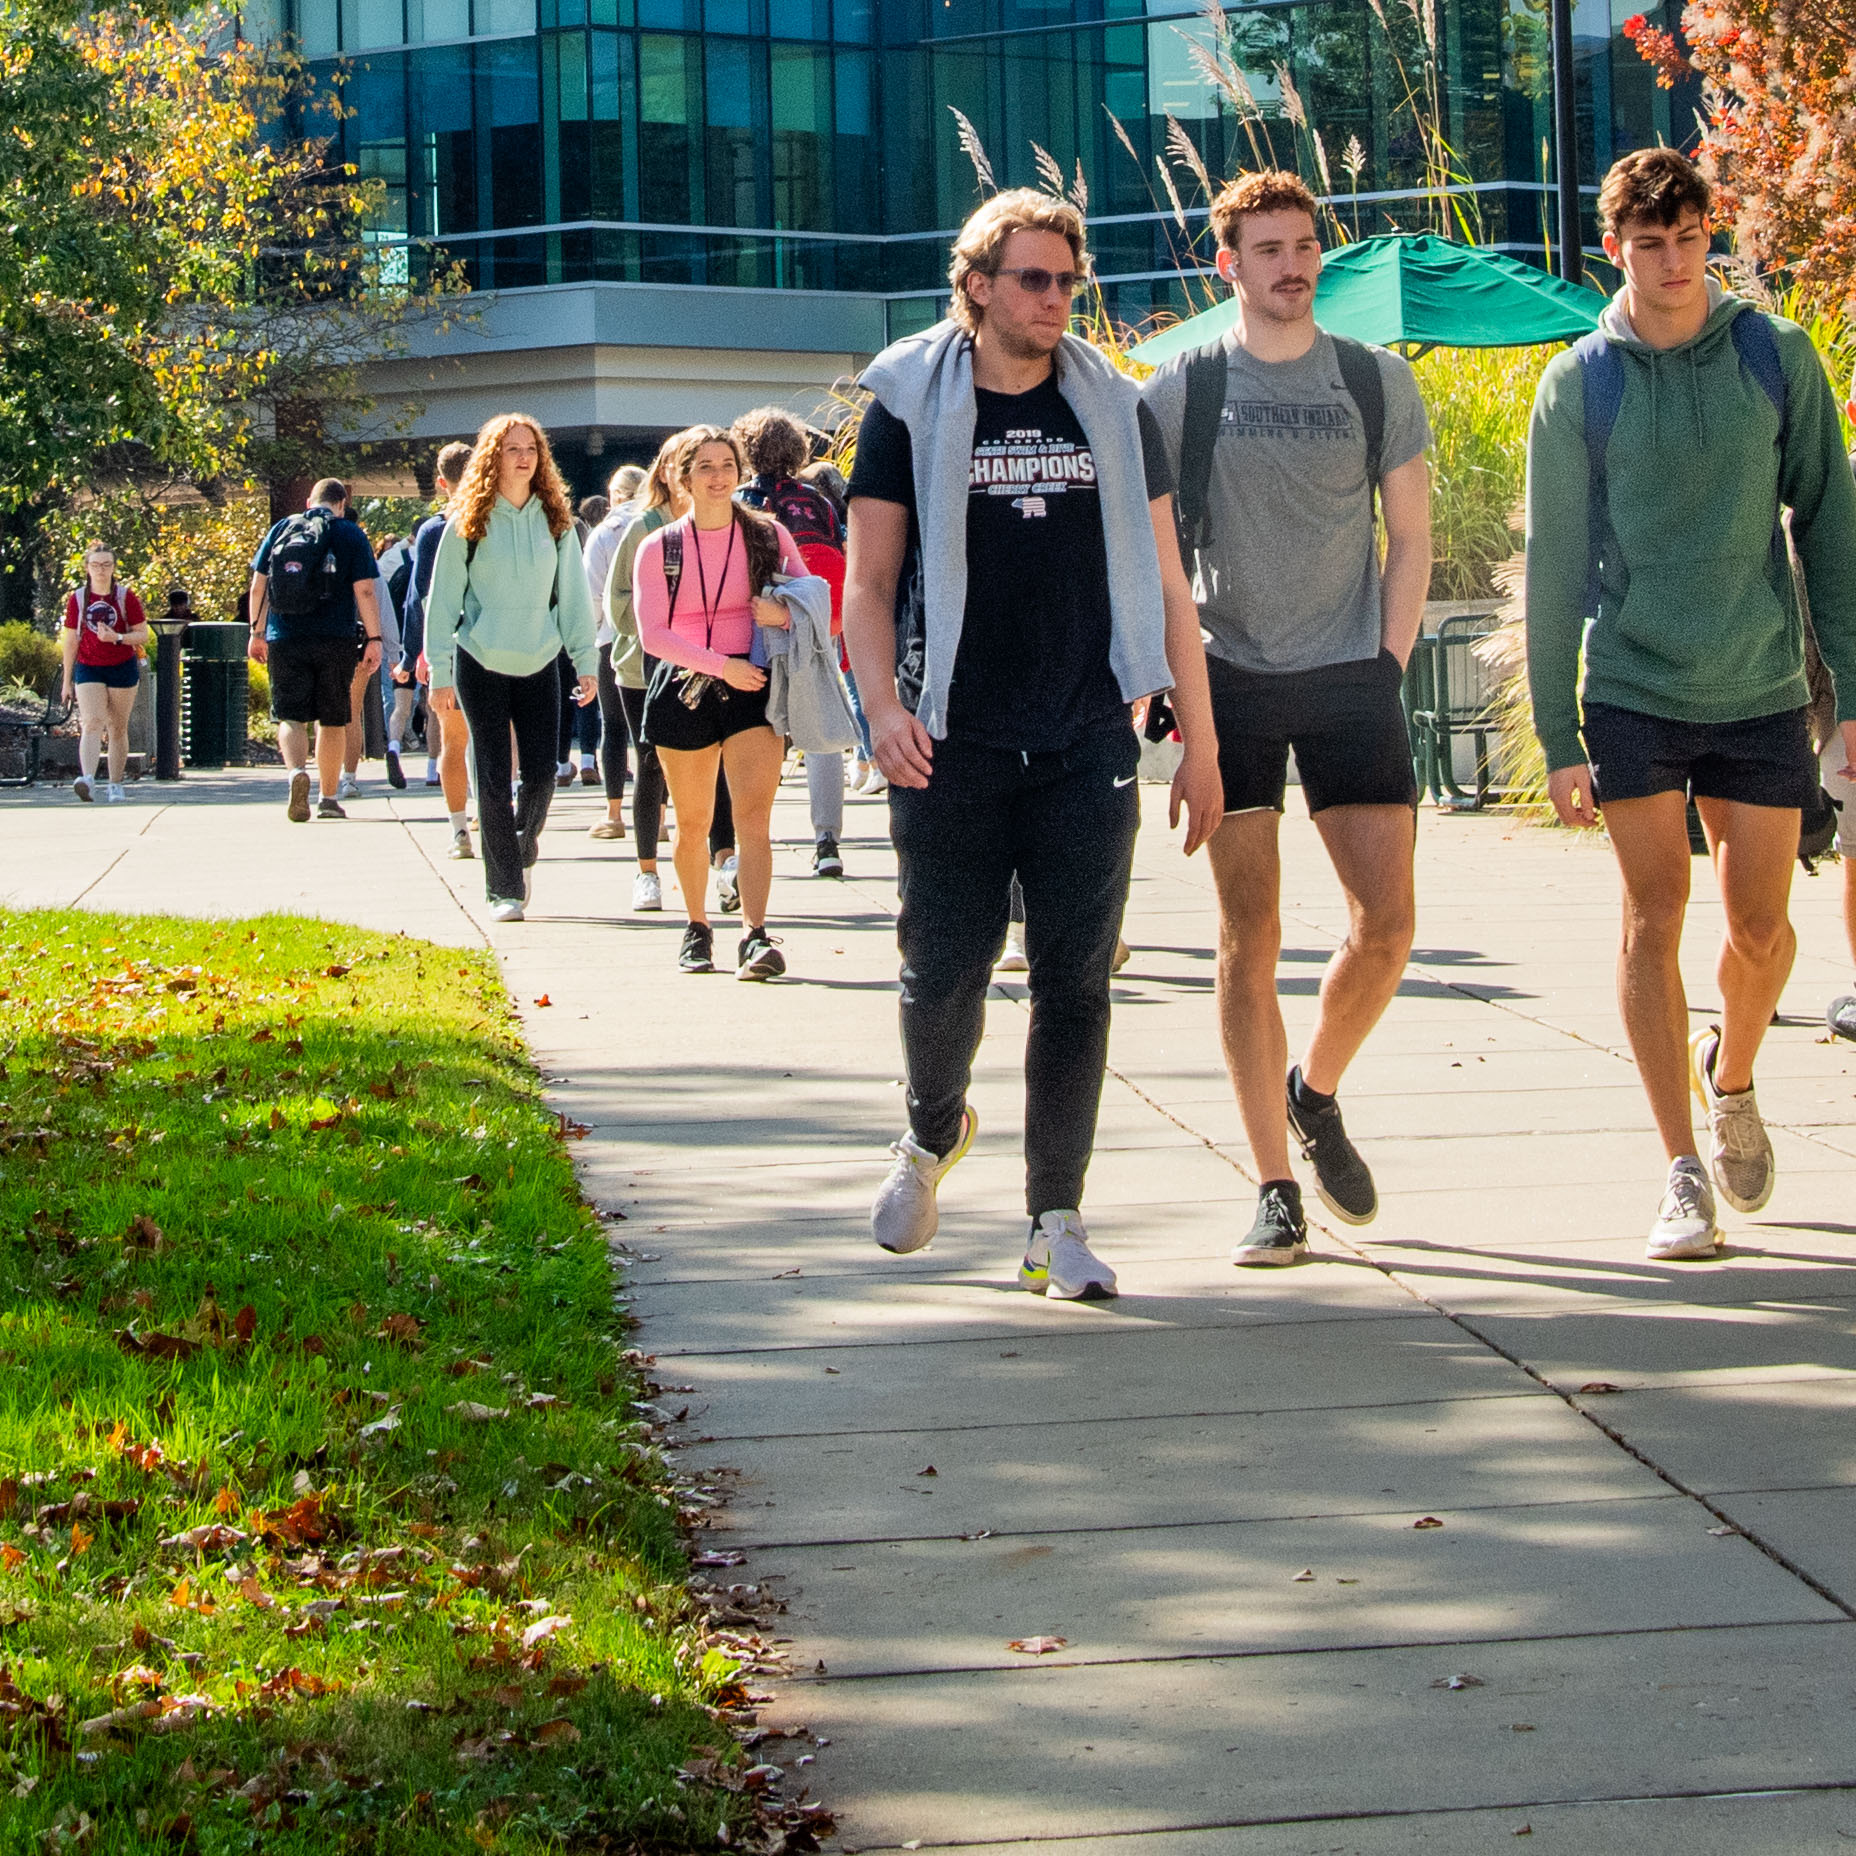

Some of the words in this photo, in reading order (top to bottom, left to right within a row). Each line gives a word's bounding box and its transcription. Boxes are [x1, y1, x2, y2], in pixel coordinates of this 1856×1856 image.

[1240, 404, 1299, 425] SOUTHERN
[1006, 429, 1042, 439] 2019
[982, 437, 1064, 446] COLORADO
[1007, 445, 1037, 455] SWIM
[987, 484, 1031, 495] CHERRY
[1031, 482, 1067, 494] CREEK
